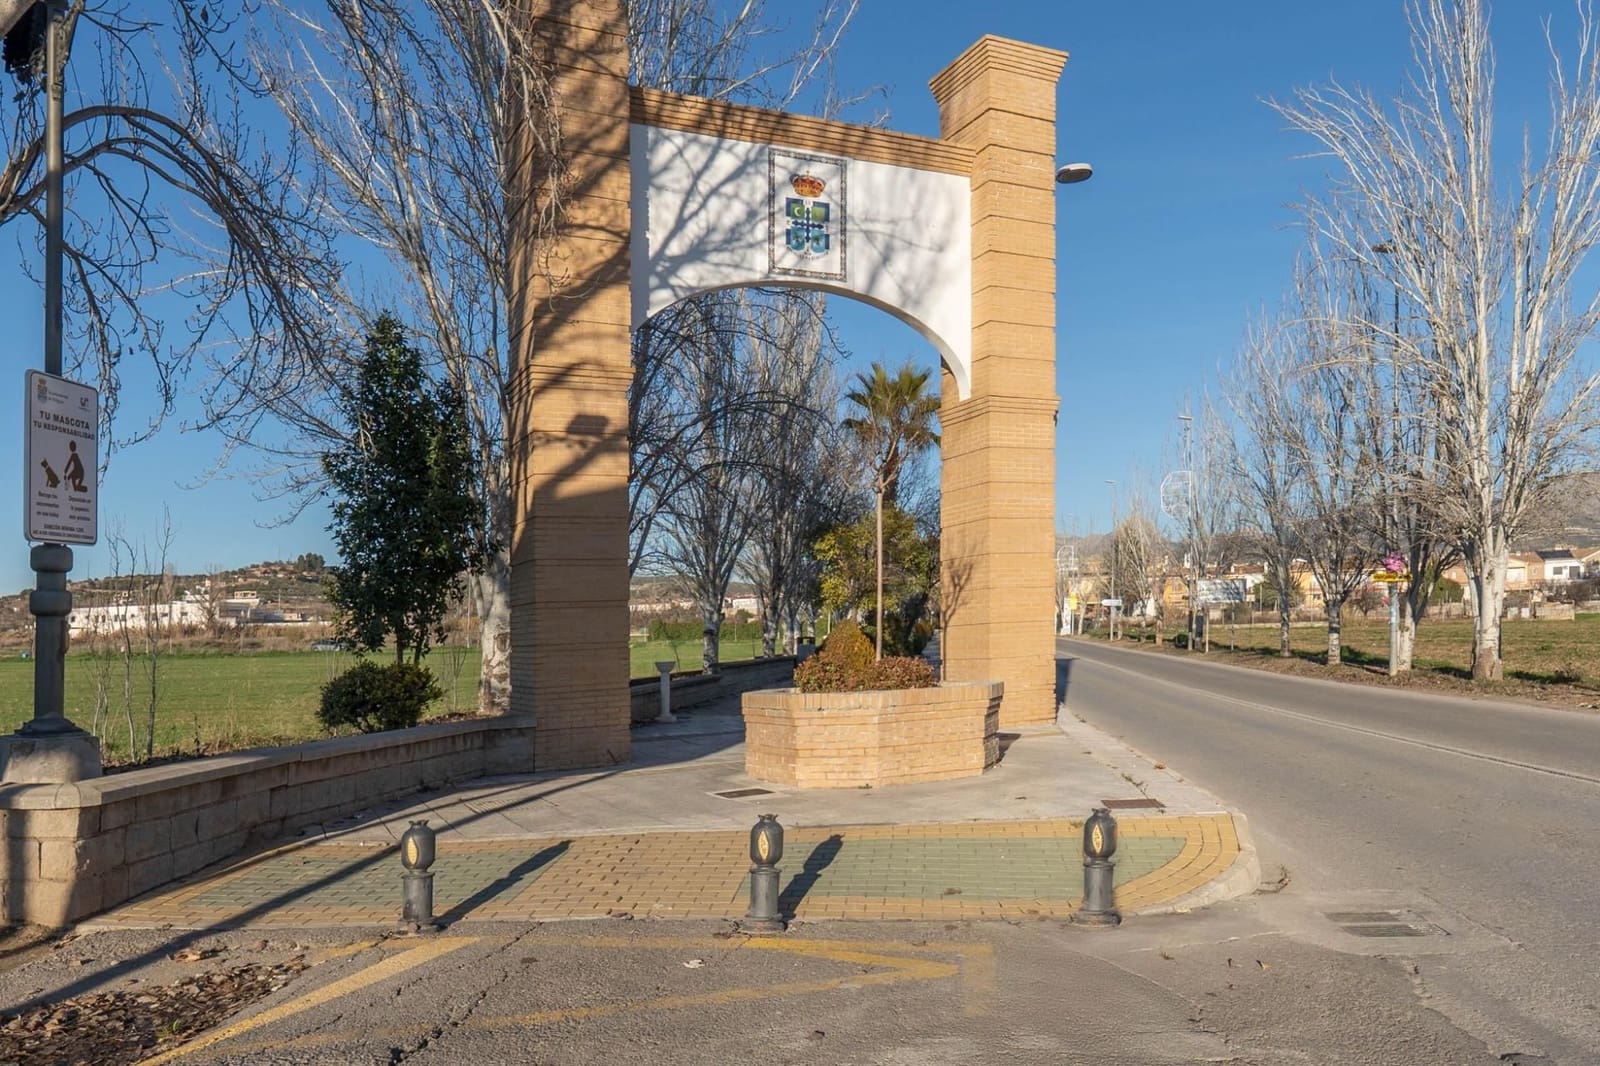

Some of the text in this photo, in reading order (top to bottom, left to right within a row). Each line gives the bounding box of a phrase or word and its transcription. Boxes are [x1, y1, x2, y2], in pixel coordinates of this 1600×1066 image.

[33, 420, 95, 440] TU RESPONSABILIDAD
[40, 410, 90, 430] TU MASCOTA
